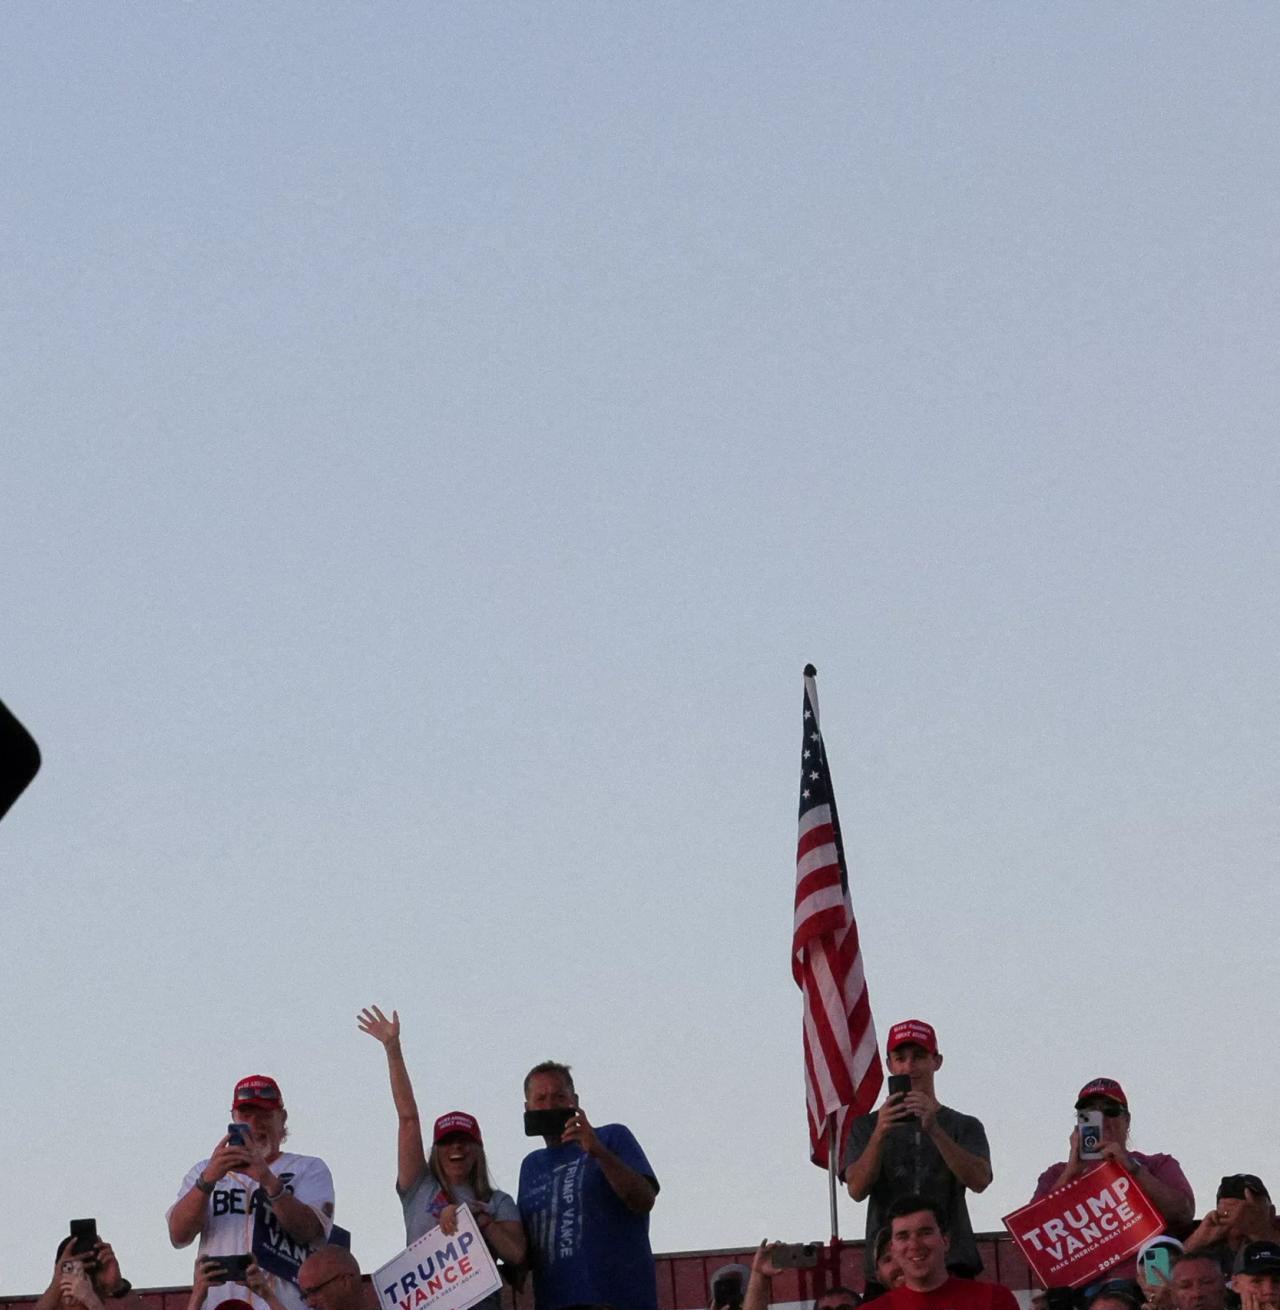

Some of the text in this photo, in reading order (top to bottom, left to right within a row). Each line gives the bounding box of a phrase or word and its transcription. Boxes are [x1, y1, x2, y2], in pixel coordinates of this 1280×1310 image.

[559, 1158, 581, 1258] TRUMP VANCE
[1023, 1178, 1134, 1253] TRUMP
[1046, 1202, 1137, 1261] VANCE
[383, 1232, 474, 1304] TRUMP
[1050, 1257, 1070, 1272] MAKE
[1069, 1242, 1100, 1264] AMERICA
[1099, 1231, 1122, 1249] GREAT
[1097, 1254, 1122, 1271] 2024
